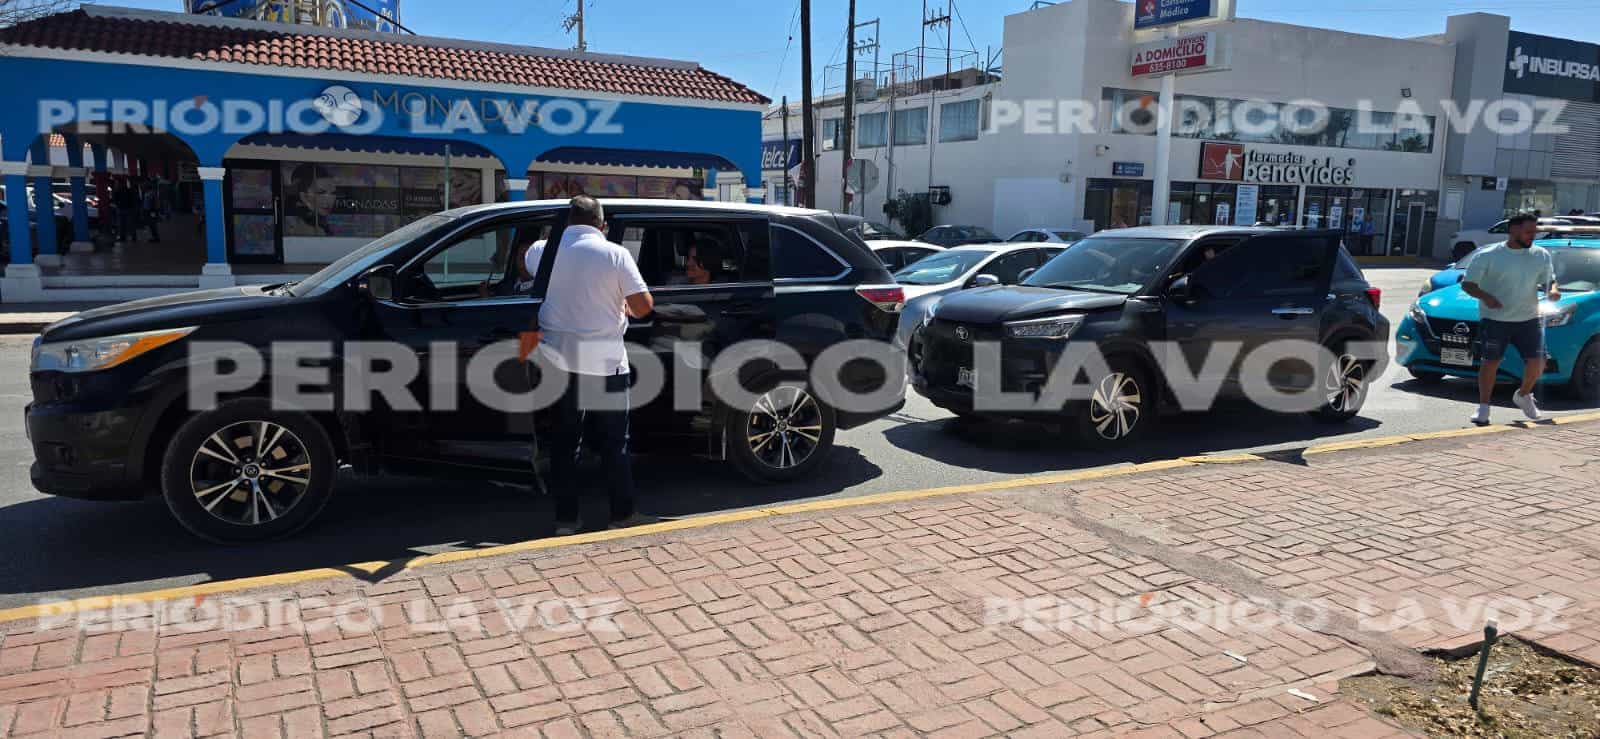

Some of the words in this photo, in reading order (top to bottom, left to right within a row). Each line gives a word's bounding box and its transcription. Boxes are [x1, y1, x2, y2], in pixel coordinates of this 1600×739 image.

[1135, 52, 1143, 63] A
[1146, 43, 1205, 61] DOMICILIO
[1529, 56, 1600, 80] INBURSA
[1250, 150, 1305, 164] farmacias
[1244, 154, 1354, 185] benavides
